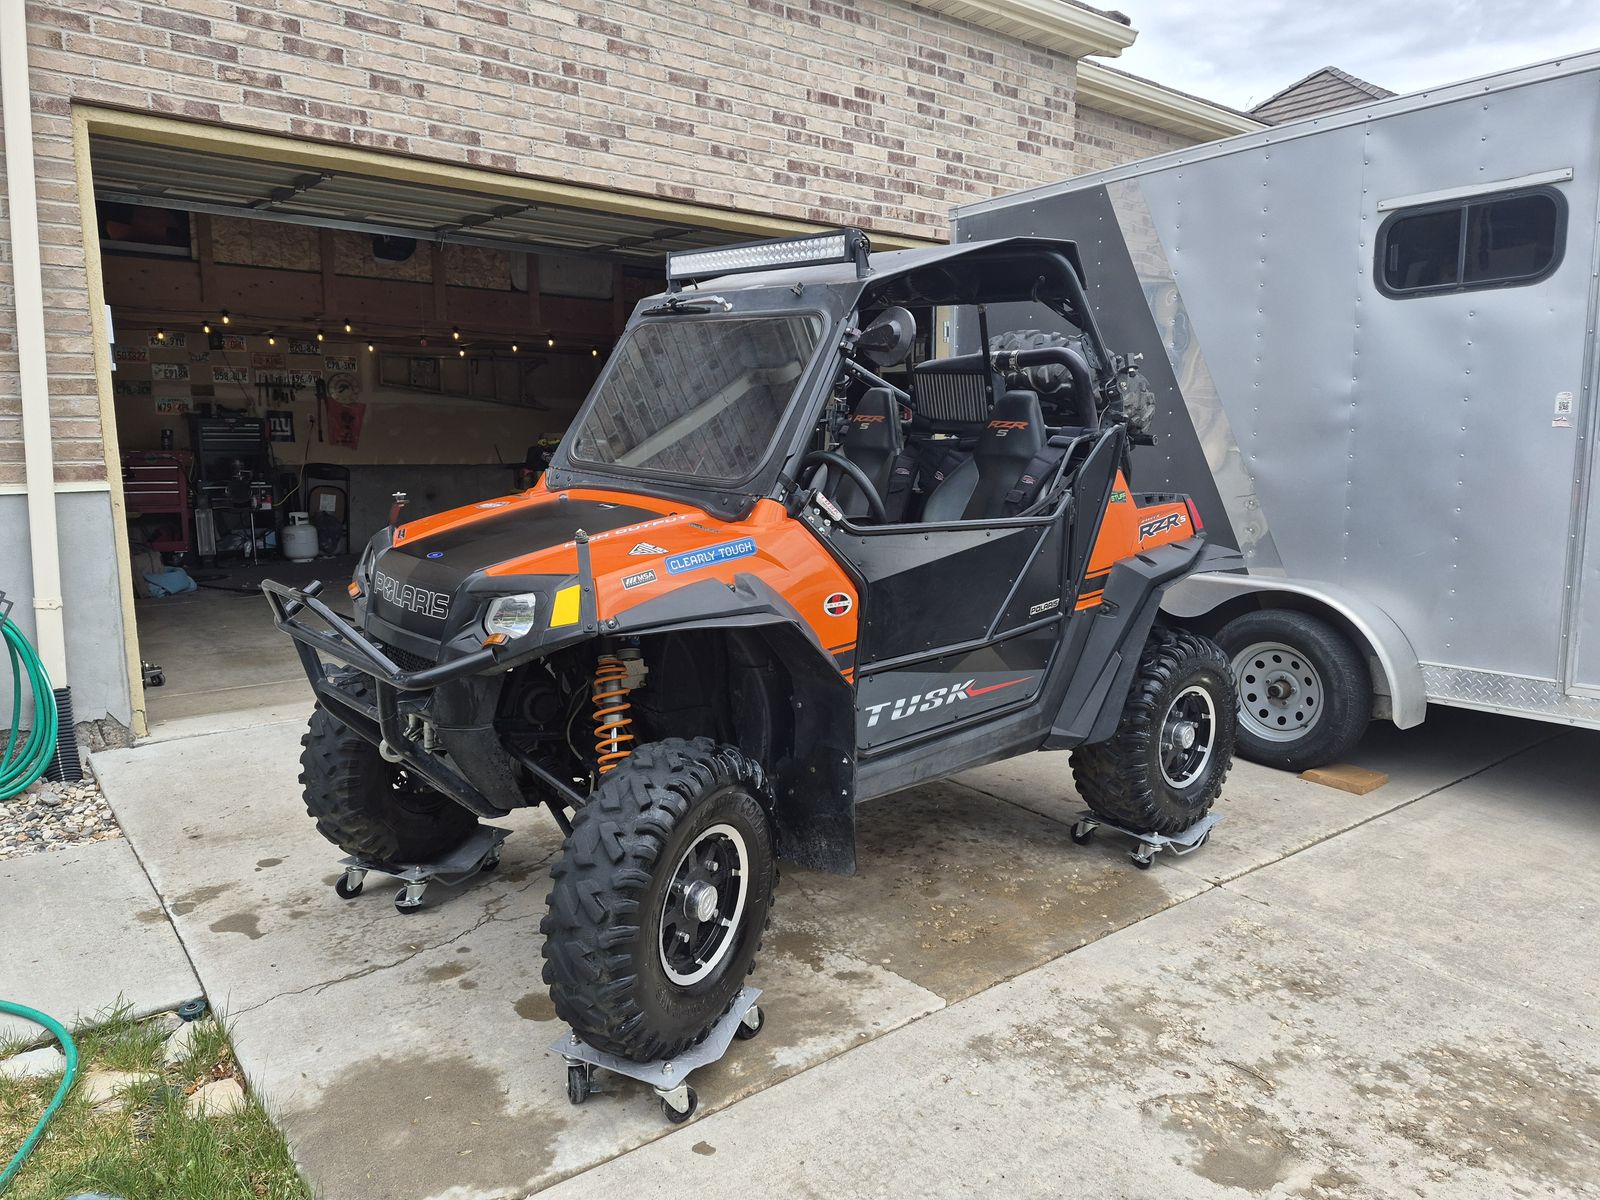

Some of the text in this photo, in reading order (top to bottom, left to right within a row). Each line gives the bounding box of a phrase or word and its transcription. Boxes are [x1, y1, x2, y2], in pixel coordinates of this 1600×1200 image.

[853, 415, 886, 423] RZR
[987, 420, 1029, 429] RZR
[616, 515, 689, 534] OUTPUT
[1138, 512, 1182, 544] RZR
[669, 542, 753, 570] CLEARLY TOUGH
[373, 570, 450, 620] POLARIS
[1031, 599, 1059, 614] POLARIS
[865, 678, 976, 728] TUSK
